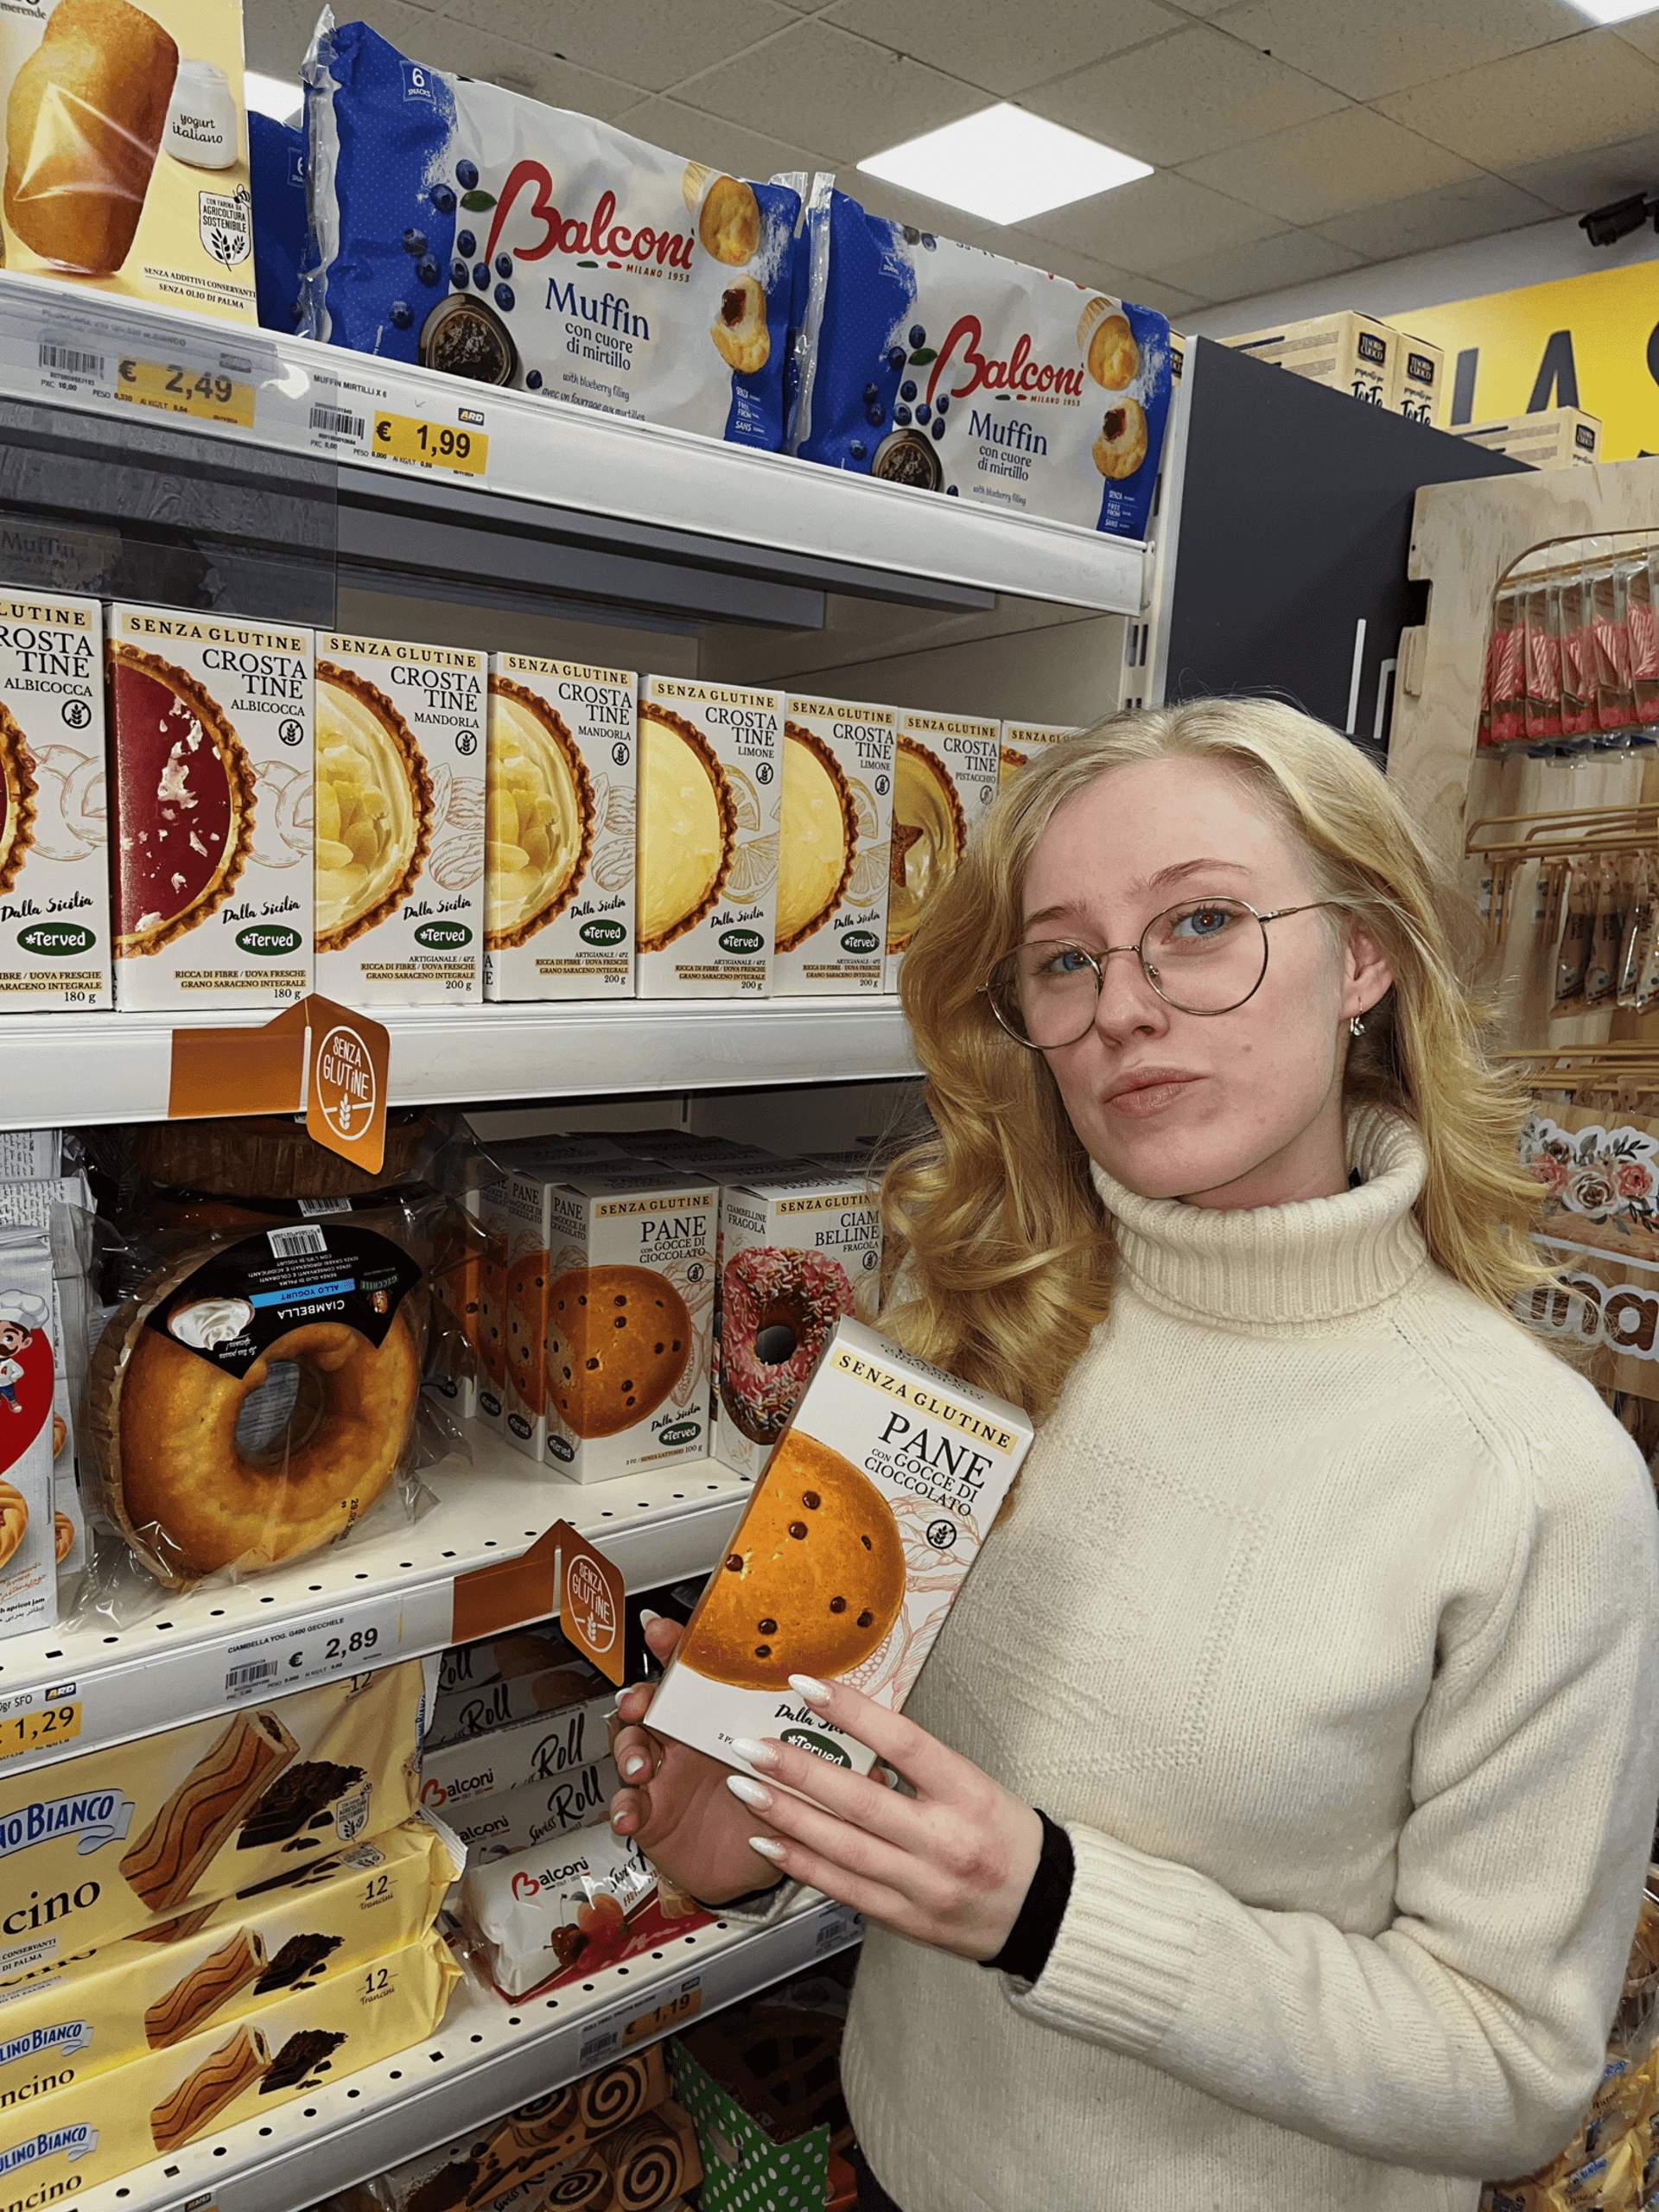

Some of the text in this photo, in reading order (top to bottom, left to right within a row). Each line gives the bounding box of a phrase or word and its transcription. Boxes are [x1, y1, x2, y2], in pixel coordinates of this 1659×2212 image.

[412, 67, 425, 87] 6
[408, 88, 431, 98] SNACKS
[180, 113, 215, 130] yogurt
[172, 122, 223, 144] italiano
[202, 205, 246, 222] AGRICOLTURA
[202, 214, 246, 233] SOSTENIBILE
[485, 159, 695, 270] Balconi
[143, 266, 257, 299] SENZA ADDITIVI CONSERVANTI
[626, 264, 690, 283] MILANO 1953
[159, 283, 245, 309] SENZA PALMA
[545, 277, 650, 341] Muffin
[564, 321, 633, 354] con cuore
[582, 345, 632, 371] mirtillo
[926, 315, 1084, 406] Balconi
[165, 365, 232, 403] 2,49
[314, 374, 375, 396] MUFFIN MIRTILLI
[376, 421, 391, 442] €
[416, 424, 470, 458] 1,99
[968, 410, 1048, 456] Muffin
[979, 444, 1032, 467] con cuore
[990, 462, 1029, 481] mirtillo
[130, 618, 302, 651] SENZA GLUTINE
[16, 650, 90, 678] TINE
[202, 648, 308, 680] CROSTA
[330, 639, 476, 668] SENZA GLUTINE
[391, 665, 481, 694] CROSTA
[509, 657, 628, 684] SENZA GLUTINE
[4, 678, 93, 696] ALBICOCCA
[242, 674, 303, 700] TINE
[558, 683, 632, 709] CROSTA
[658, 683, 774, 708] SENZA GLUTINE
[231, 699, 305, 716] ALBICOCCA
[423, 689, 478, 712] TINE
[414, 712, 480, 728] MANDORLA
[586, 704, 630, 725] TINE
[705, 707, 778, 730] CROSTA
[793, 702, 892, 724] SENZA GLUTINE
[578, 726, 632, 741] MANDORLA
[732, 727, 774, 747] TINE
[833, 723, 894, 745] CROSTA
[908, 718, 995, 737] SENZA GLUTINE
[1012, 730, 1046, 742] SENZA
[738, 747, 774, 759] LIMONE
[855, 741, 891, 760] TINE
[944, 737, 997, 757] CROSTA
[861, 760, 891, 771] LIMONE
[965, 755, 995, 772] TINE
[956, 772, 995, 784] PISTACCHIO
[1, 891, 94, 922] Dalla Sicilia
[222, 895, 301, 925] Dalla Sicilia
[404, 894, 472, 920] Dalla Sicilia
[570, 894, 626, 919] Dalla Sicilia
[710, 906, 764, 928] Dalla Sicilia
[35, 931, 86, 947] Terved
[249, 933, 294, 947] Terved
[427, 929, 465, 941] Terved
[589, 926, 620, 938] Terved
[728, 936, 759, 947] Terved
[48, 982, 102, 990] INTEGRALE
[274, 988, 292, 998] 180
[445, 980, 464, 989] 200
[65, 992, 85, 1001] 180
[333, 1036, 361, 1067] SENZA
[513, 1183, 539, 1205] PANE
[554, 1197, 582, 1221] PANE
[601, 1196, 709, 1215] SENZA GLUTINE
[727, 1204, 766, 1223] CIAMBELLINE
[780, 1200, 822, 1212] SENZA
[641, 1216, 706, 1243] PANE
[728, 1214, 766, 1234] FRAGOLA
[654, 1238, 691, 1251] GOCCE
[815, 1225, 880, 1246] BELLINE
[639, 1248, 706, 1263] CIOCCOLATO
[843, 1241, 879, 1253] FRAGOLA
[281, 1283, 340, 1300] ALLO YOGURT
[277, 1300, 345, 1319] CIAMBELLA
[839, 1355, 908, 1398] SENZA
[914, 1392, 1011, 1449] GLUTINE
[669, 1427, 696, 1440] Terved
[878, 1411, 994, 1489] PANE
[864, 1457, 972, 1516] CIOCCOLATO
[871, 1448, 978, 1503] CON GOCCE DI
[580, 1562, 603, 1596] SENZA
[6, 1598, 45, 1611] apricot jam
[227, 1618, 345, 1654] CIAMBELLA GECCHELE
[289, 1651, 303, 1668] €
[325, 1628, 378, 1659] 2,89
[15, 1694, 33, 1707] SFO
[460, 1682, 512, 1734] Roll
[16, 1707, 74, 1740] 1,29
[531, 1712, 585, 1779] Roll
[421, 1768, 494, 1808] Balconi
[547, 1764, 605, 1828] Roll
[28, 1796, 114, 1841] BIANCO
[365, 1875, 388, 1900] 12
[512, 1857, 591, 1901] Balconi
[3, 1882, 100, 1936] cino
[359, 1891, 394, 1910] Trancini
[2, 1937, 57, 1961] CONSERVANTI
[13, 1953, 42, 1968] PALMA
[365, 1968, 389, 1994] 12
[359, 1986, 395, 2005] Trancini
[652, 1993, 690, 2023] 1,19
[32, 2024, 83, 2050] BIANCO
[37, 2126, 87, 2156] BIANCO
